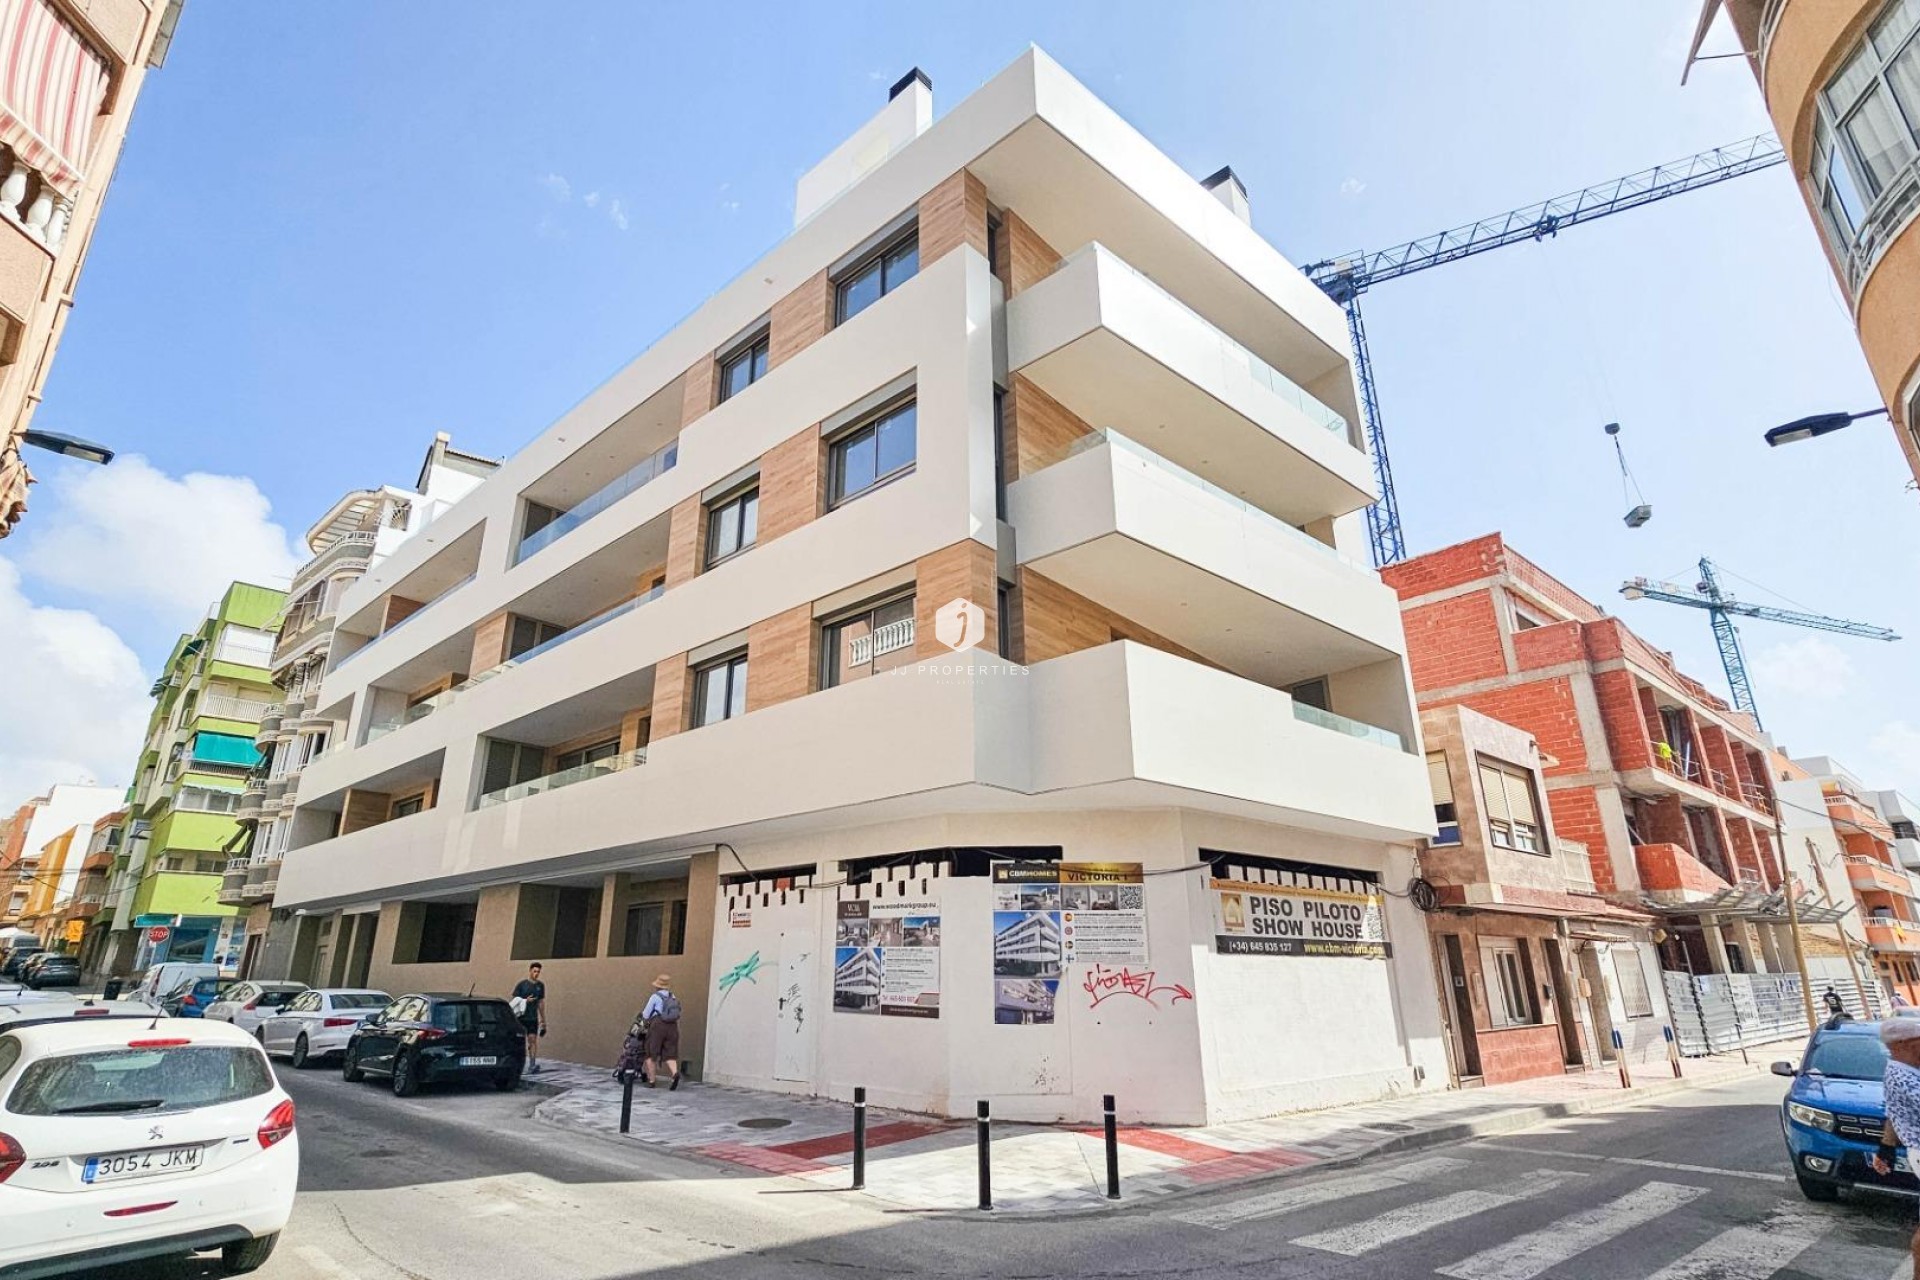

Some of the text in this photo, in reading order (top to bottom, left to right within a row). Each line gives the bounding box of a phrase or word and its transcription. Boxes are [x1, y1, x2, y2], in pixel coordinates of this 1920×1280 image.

[1068, 872, 1120, 881] VICTORIA
[1249, 895, 1362, 922] PISO PILOTO
[150, 930, 168, 938] STOP
[1252, 917, 1364, 939] SHOW HOUSE
[1229, 941, 1248, 953] (+34)
[98, 1148, 197, 1175] 3054 JKM
